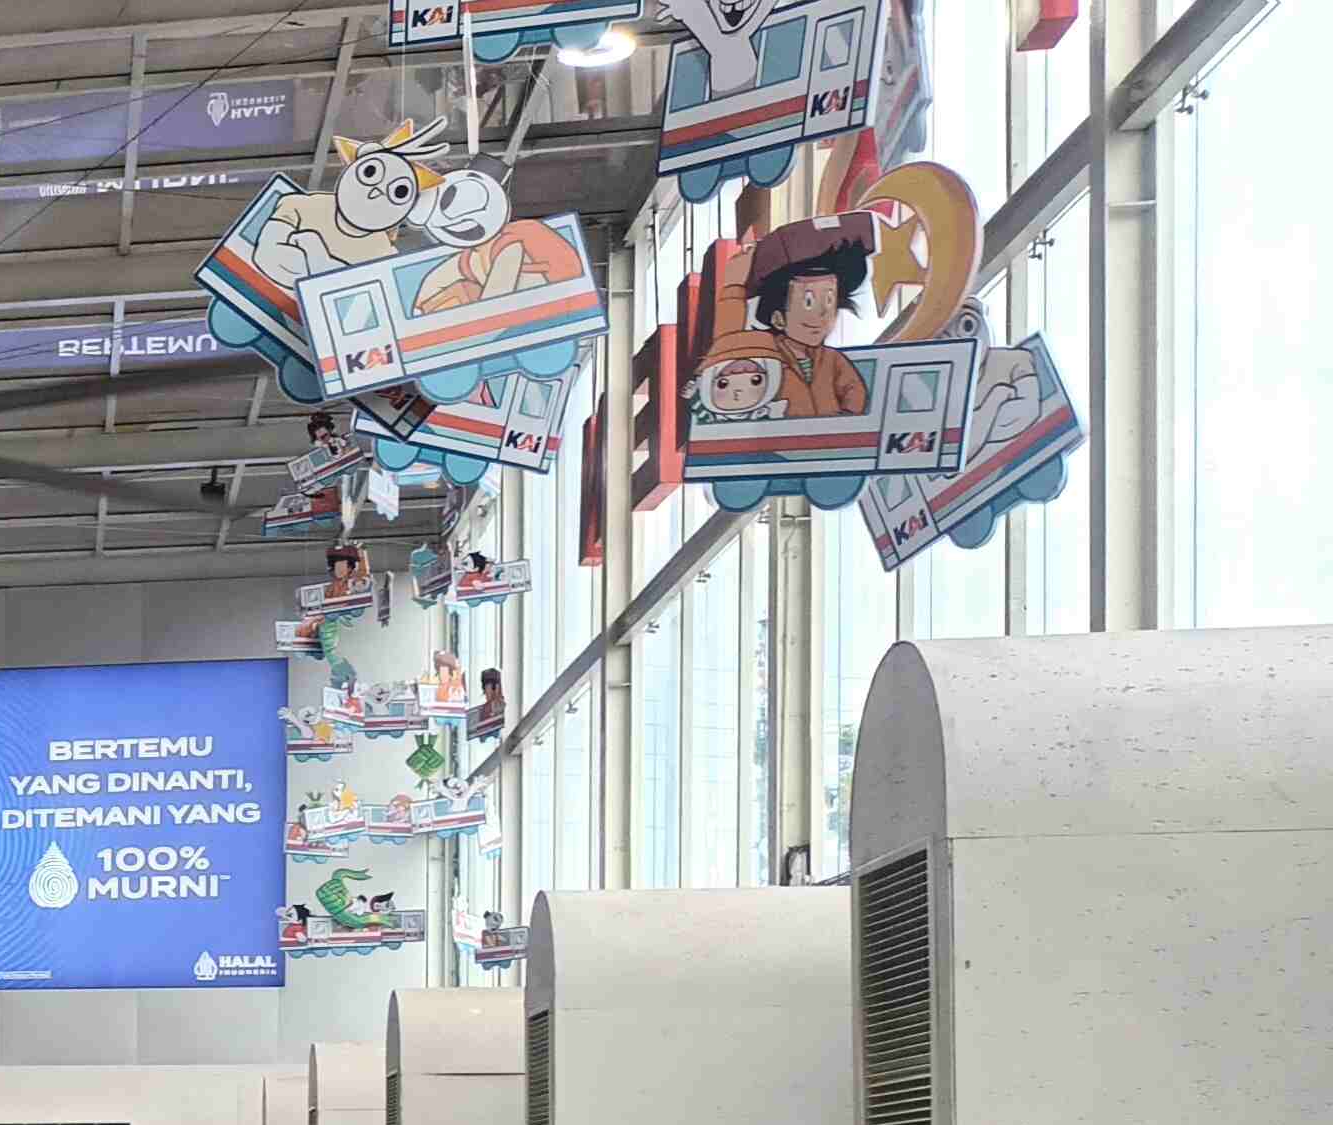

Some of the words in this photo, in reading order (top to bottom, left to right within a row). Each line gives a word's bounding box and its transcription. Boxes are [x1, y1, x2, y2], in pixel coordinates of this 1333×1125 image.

[48, 735, 214, 762] BERTEMU
[9, 773, 101, 796] YANG
[106, 768, 254, 793] DINANTI,
[1, 805, 162, 830] DITEMANI
[165, 802, 262, 825] YANG
[96, 846, 211, 872] 100%
[219, 955, 277, 968] HALAL
